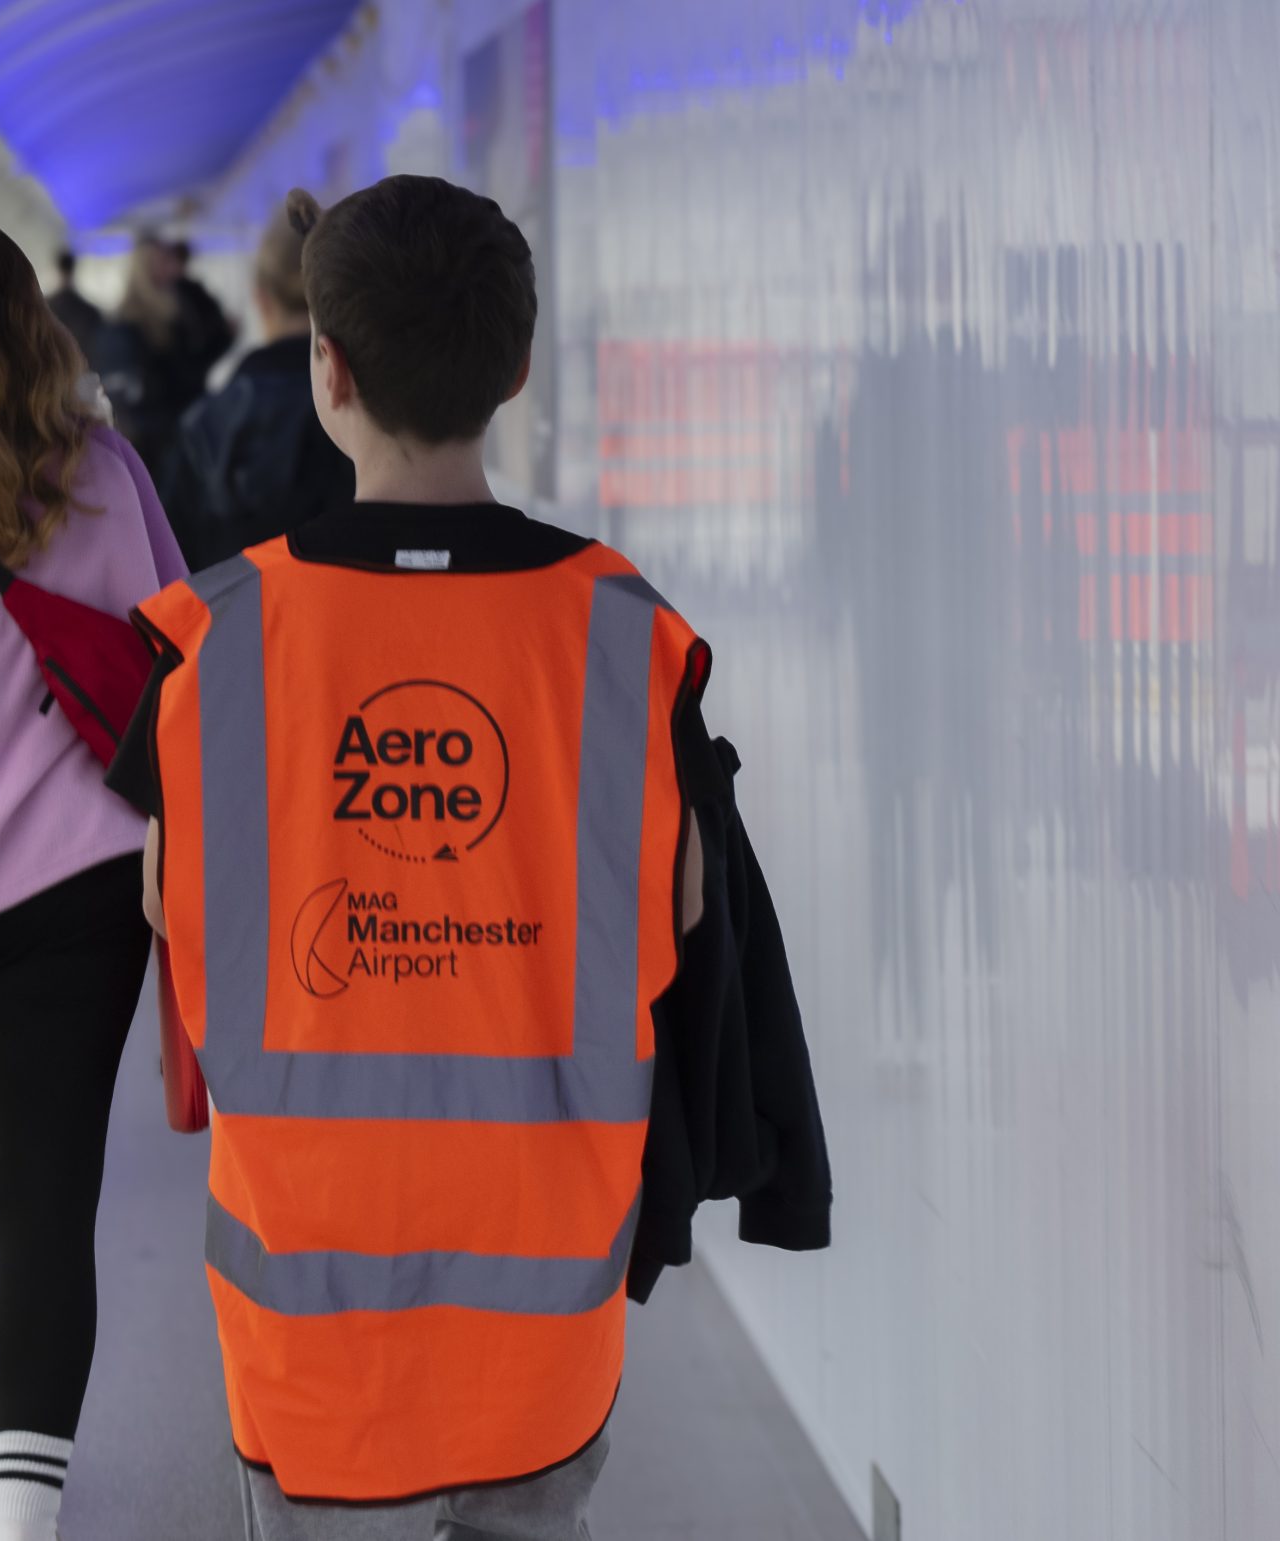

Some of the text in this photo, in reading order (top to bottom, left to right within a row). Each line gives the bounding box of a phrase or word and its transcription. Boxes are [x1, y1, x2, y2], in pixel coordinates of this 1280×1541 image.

[333, 715, 473, 767] Aero
[333, 771, 482, 822] Zone
[347, 891, 398, 911] MAG
[347, 913, 543, 945] Manchester
[347, 947, 458, 985] Airport
